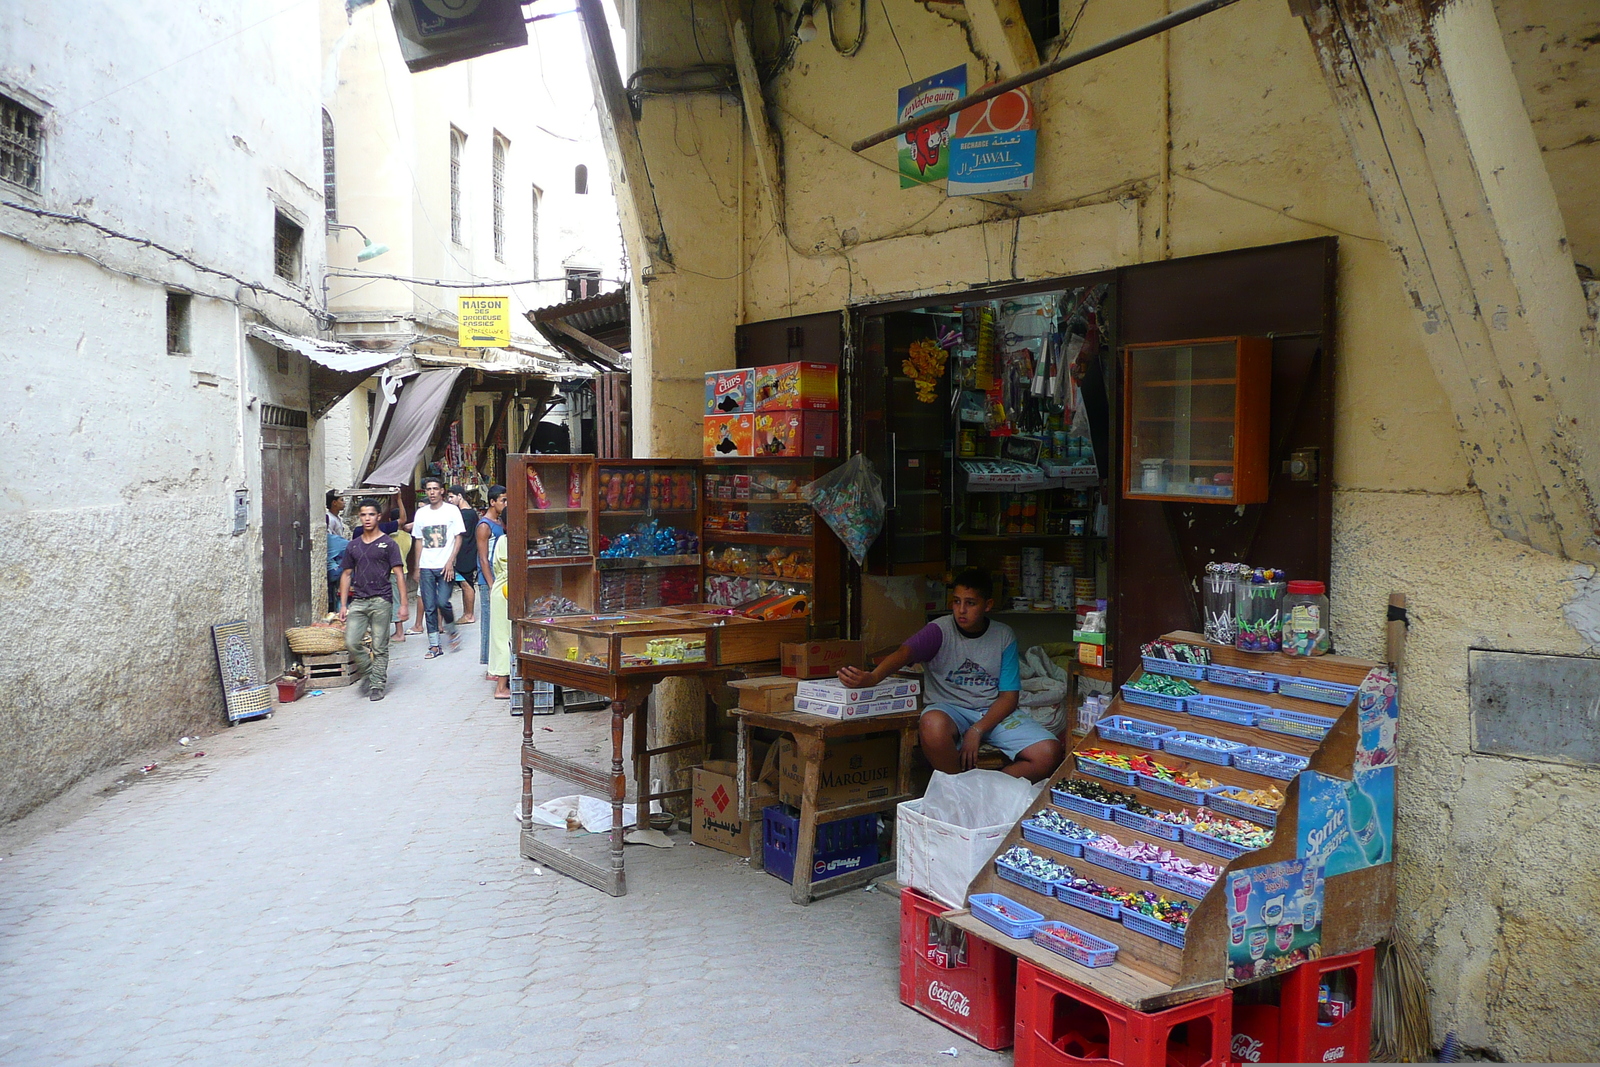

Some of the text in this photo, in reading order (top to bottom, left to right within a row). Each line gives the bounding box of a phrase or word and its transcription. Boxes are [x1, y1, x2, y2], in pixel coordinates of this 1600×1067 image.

[960, 140, 989, 150] RECHARGE
[991, 134, 1021, 146] تعبئة
[972, 150, 1013, 168] JAWAL
[462, 300, 502, 309] MAISON
[719, 374, 742, 393] CHIPS
[820, 766, 889, 790] MARQUISE
[703, 807, 716, 819] Plus
[1305, 808, 1345, 858] Sprite
